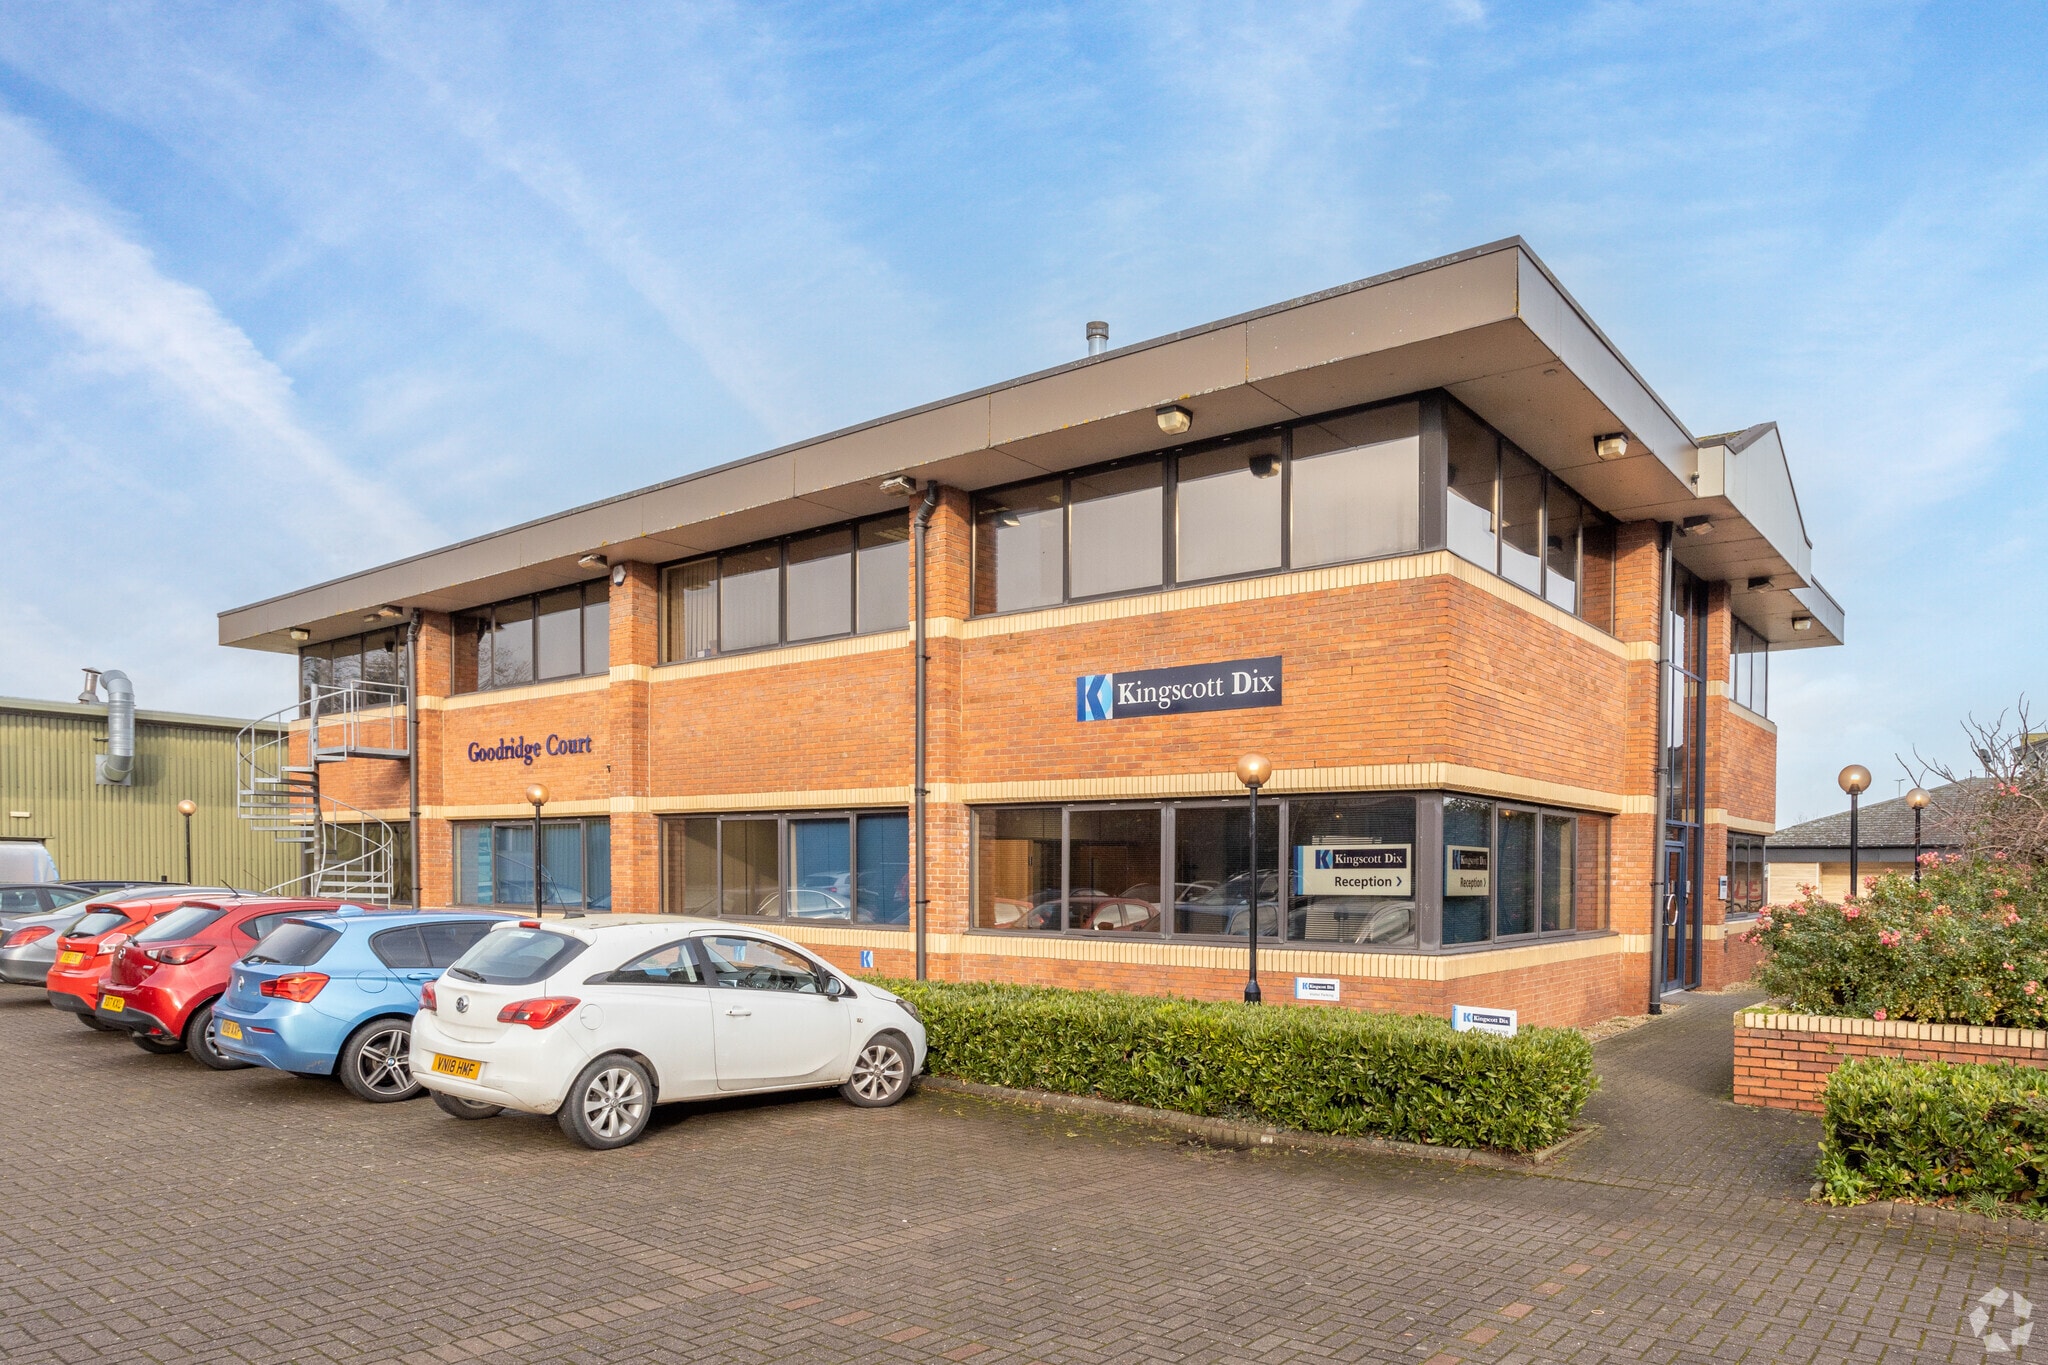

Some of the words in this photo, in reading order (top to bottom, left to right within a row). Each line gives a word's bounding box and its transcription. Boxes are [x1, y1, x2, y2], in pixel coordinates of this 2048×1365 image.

[1117, 677, 1224, 709] Kingscott
[1232, 669, 1275, 695] Dix
[468, 735, 541, 766] Goodridge
[546, 734, 592, 756] Court
[1335, 853, 1381, 867] Kingscott
[1384, 853, 1403, 864] Dix
[1335, 876, 1392, 889] Reception
[1460, 877, 1482, 890] Reception
[1473, 1015, 1498, 1024] Kingscott
[437, 1056, 456, 1073] VN18
[456, 1060, 475, 1077] HMF
